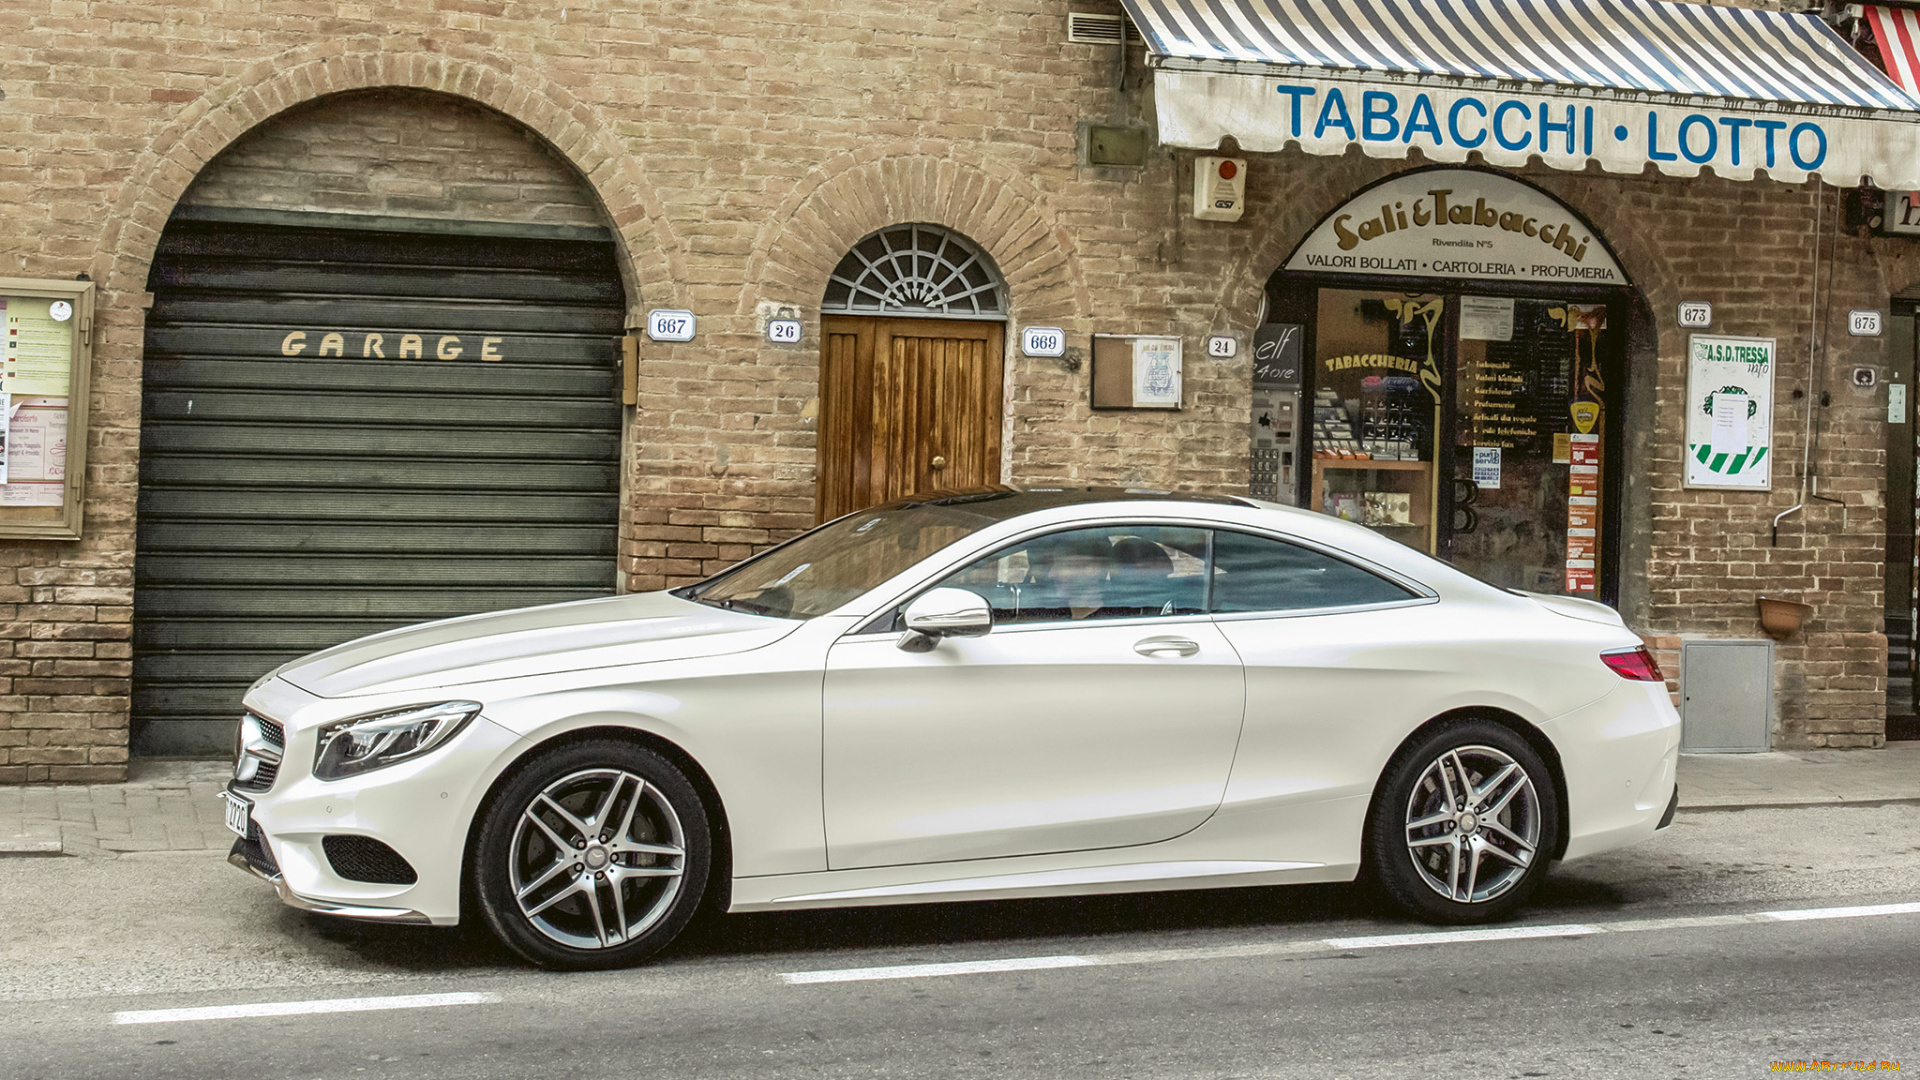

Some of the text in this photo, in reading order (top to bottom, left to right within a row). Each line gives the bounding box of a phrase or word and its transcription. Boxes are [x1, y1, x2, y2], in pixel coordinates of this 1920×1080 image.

[1277, 85, 1827, 171] TABACCHI LOTTO
[1333, 201, 1409, 251] Sali
[1428, 189, 1591, 262] Tabacchi
[1432, 238, 1474, 248] Rivendita
[1306, 254, 1615, 280] VALORI BOLLATI CARTOLERIA PROFUMERIA
[1684, 308, 1706, 322] 673
[657, 318, 686, 334] 667
[775, 325, 795, 338] 26
[1854, 317, 1876, 330] 675
[281, 331, 504, 362] GARAGE
[1030, 335, 1057, 350] 669
[1214, 341, 1229, 354] 24
[1252, 327, 1298, 361] elf
[1325, 354, 1418, 374] TABACCHERIA
[1747, 362, 1769, 378] info
[1270, 368, 1295, 379] ore
